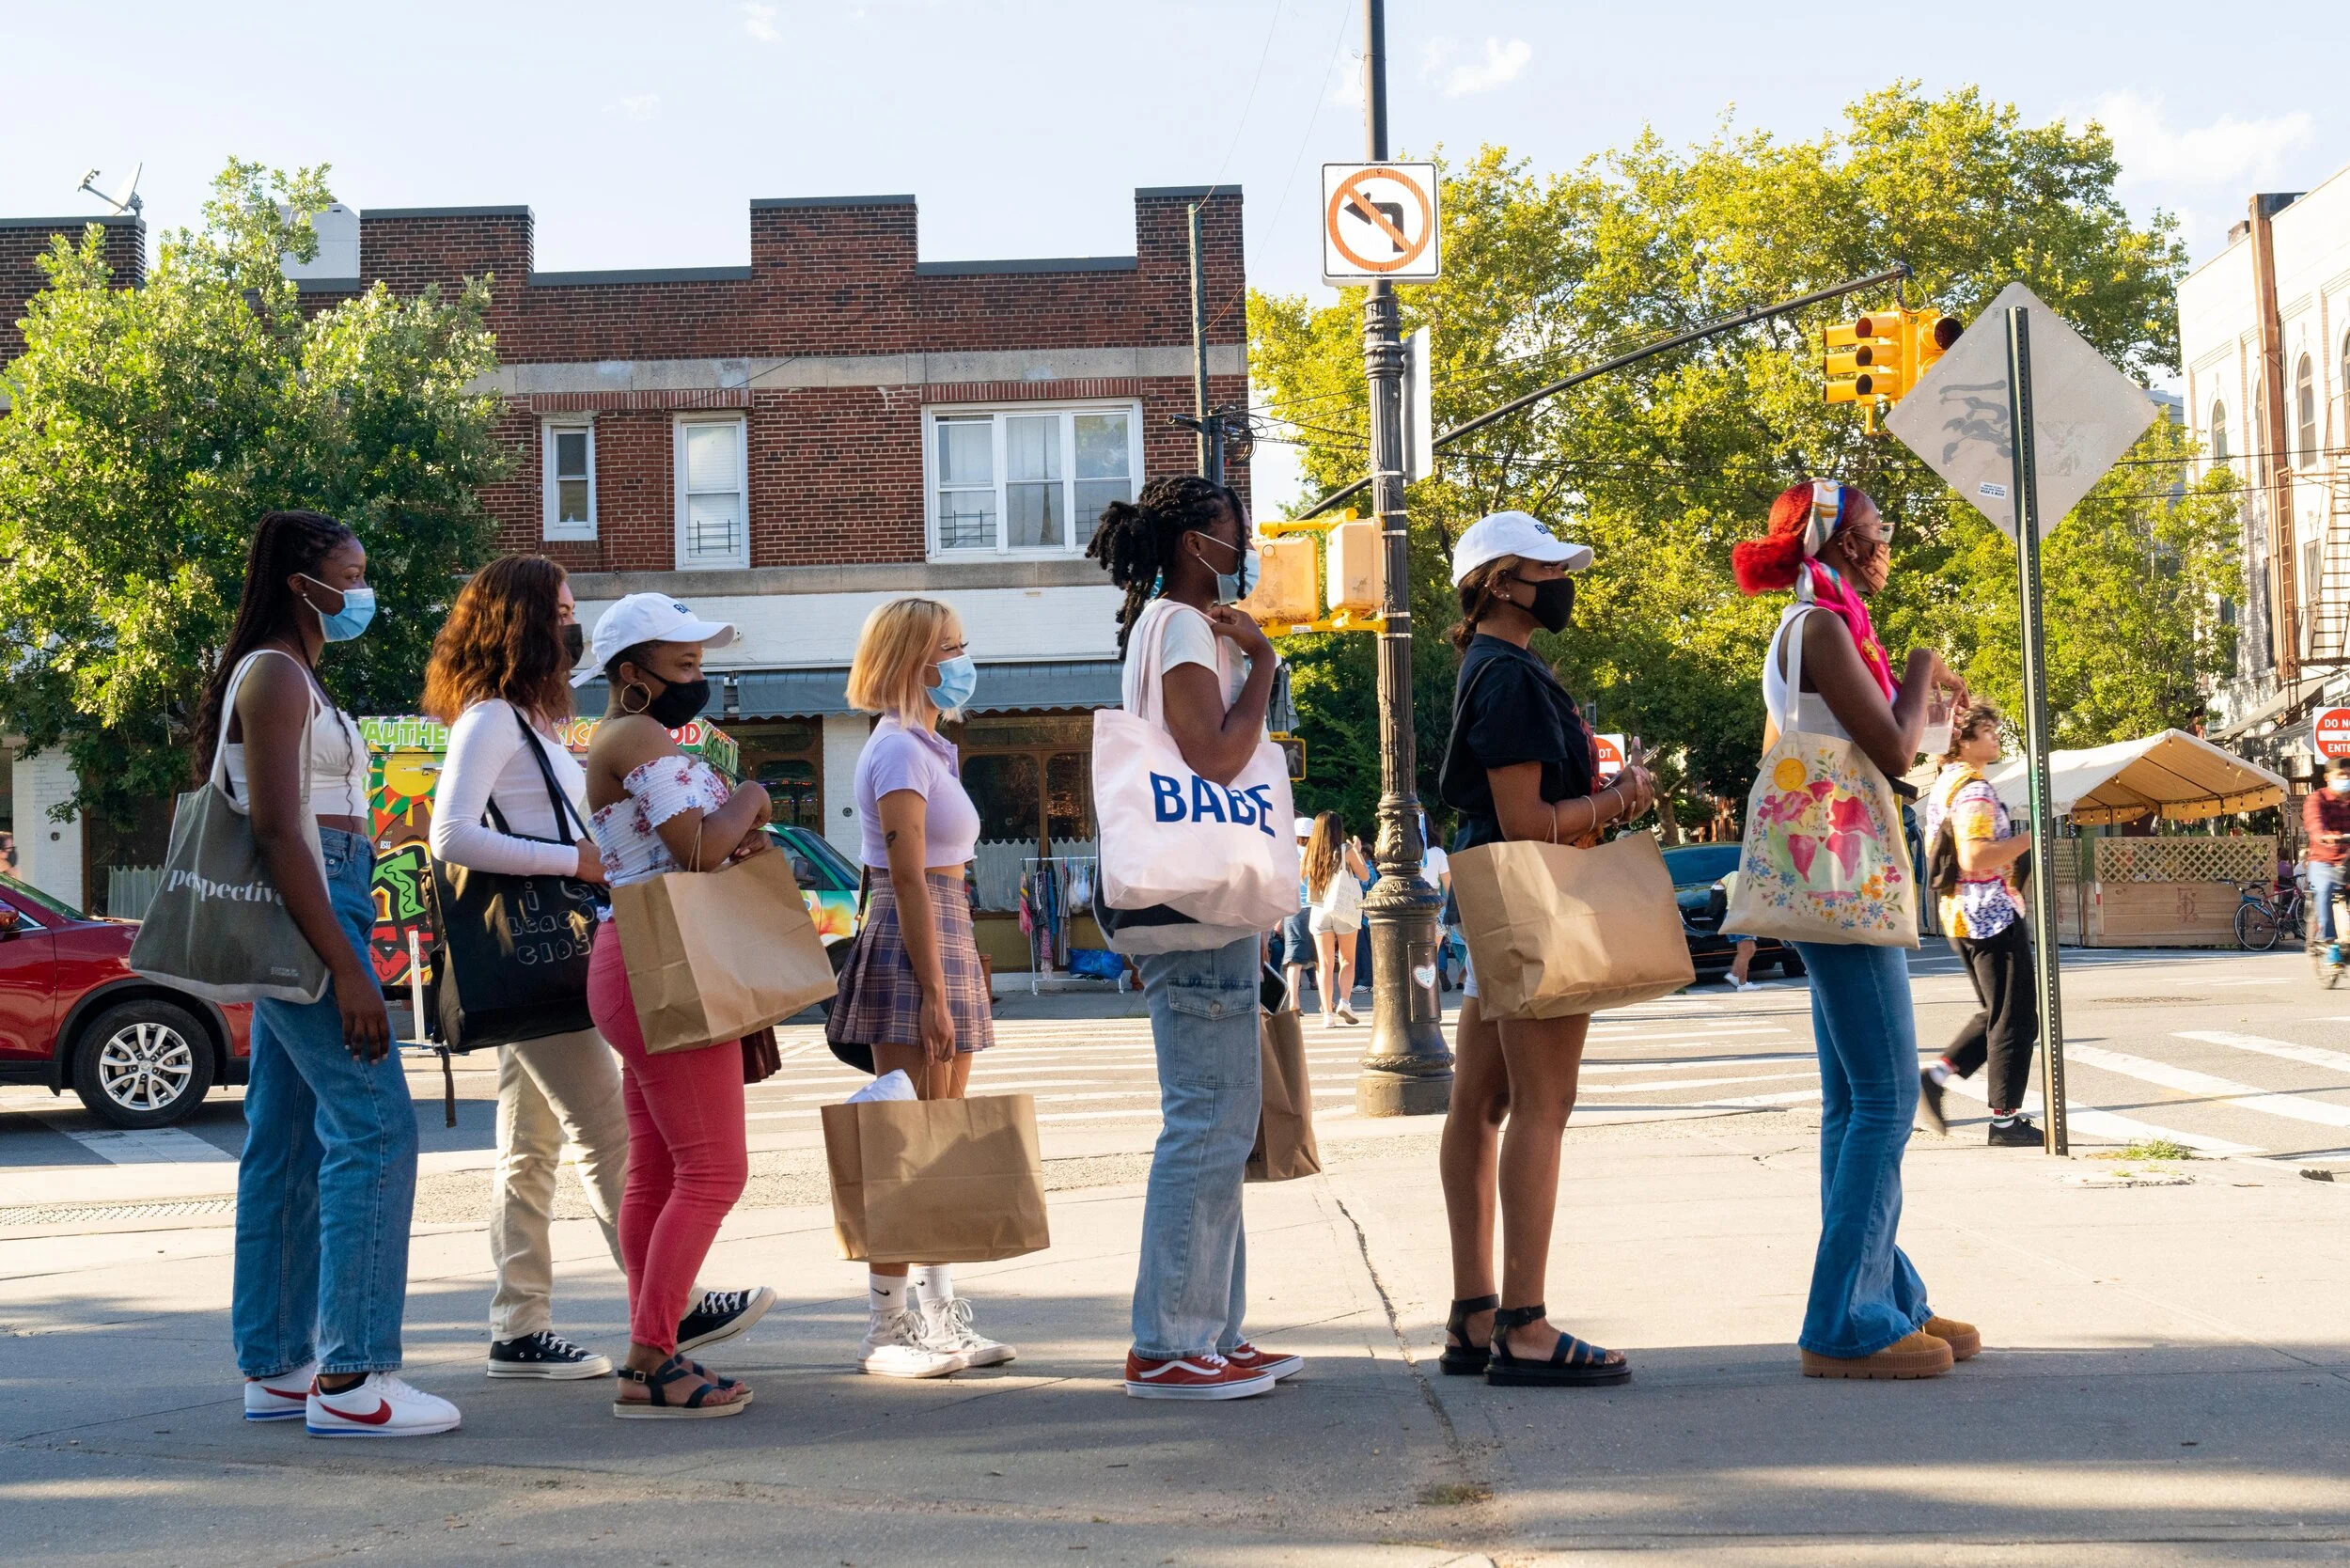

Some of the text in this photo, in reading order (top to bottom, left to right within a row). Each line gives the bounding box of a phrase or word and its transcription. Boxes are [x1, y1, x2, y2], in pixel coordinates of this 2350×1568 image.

[2324, 718, 2350, 729] DO N
[363, 722, 449, 746] AUTHE
[664, 721, 702, 746] OD
[1598, 747, 1612, 760] OT
[1150, 770, 1276, 839] BABE
